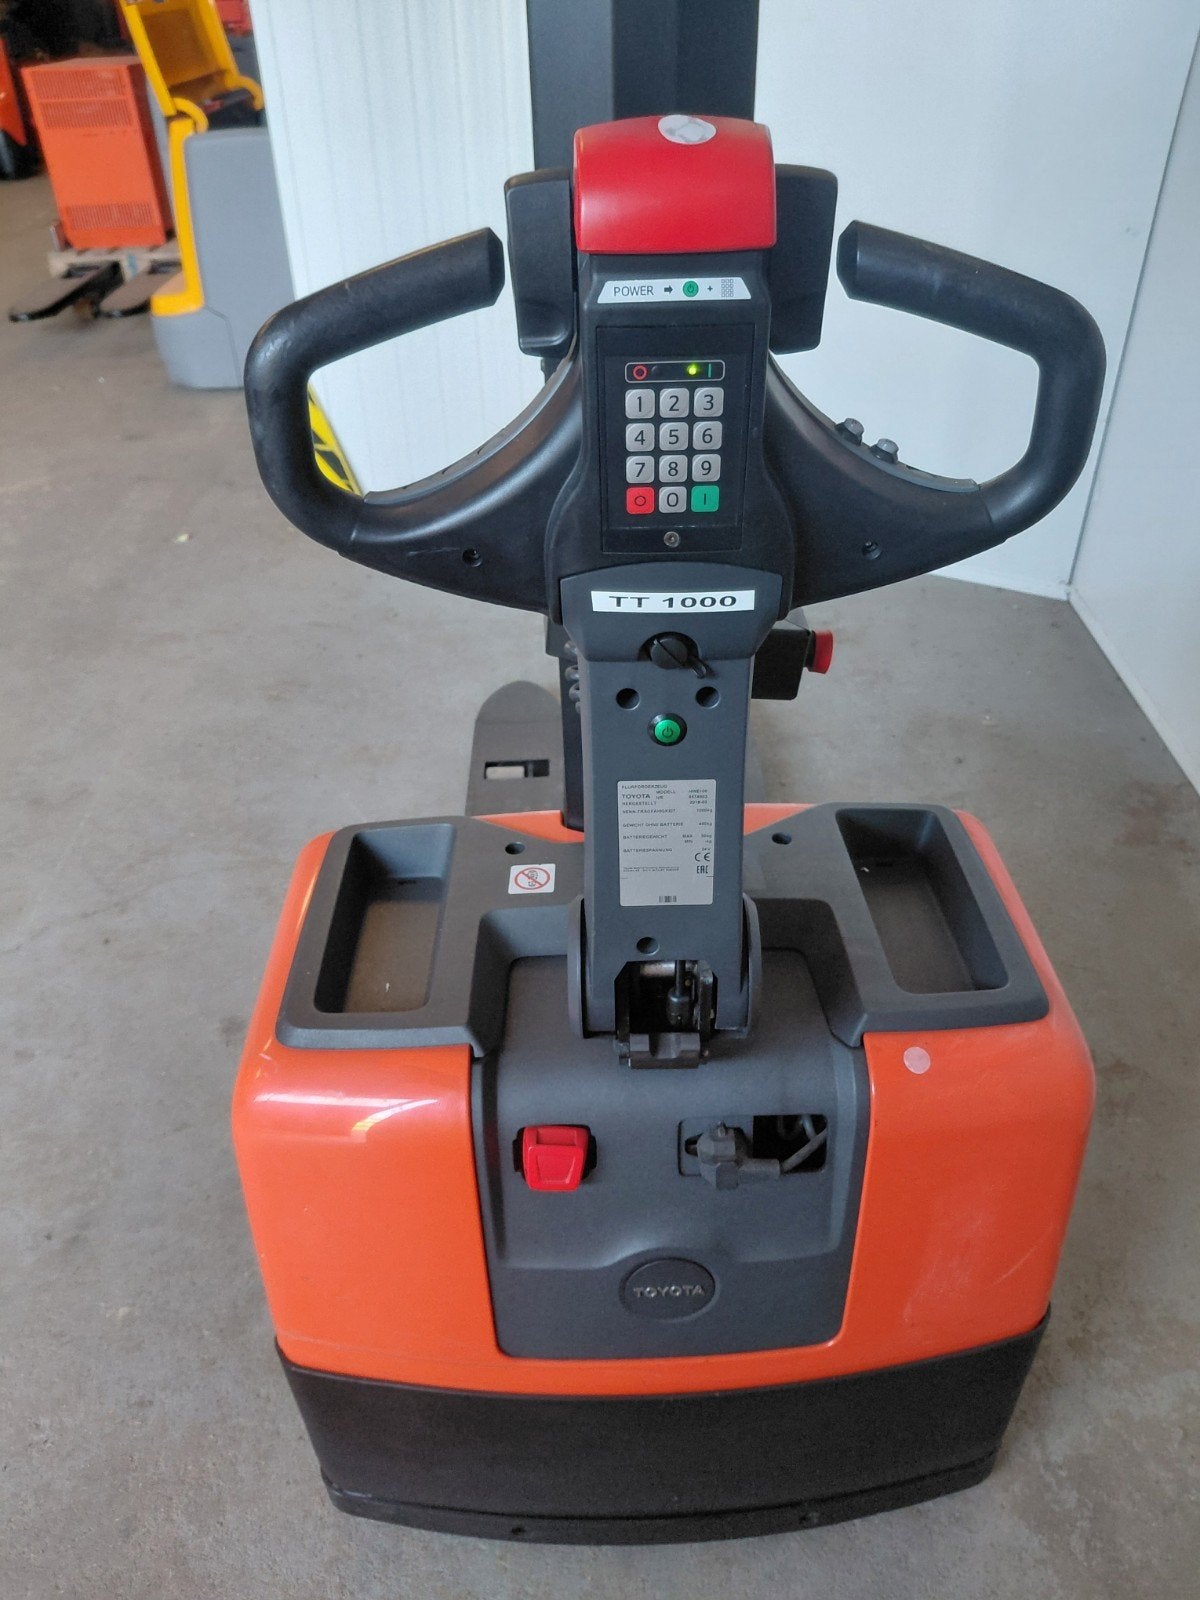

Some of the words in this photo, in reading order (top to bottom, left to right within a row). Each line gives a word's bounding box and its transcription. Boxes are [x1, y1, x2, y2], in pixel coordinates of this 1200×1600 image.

[614, 285, 654, 296] POWER
[637, 396, 643, 412] 1
[668, 395, 680, 411] 2
[703, 394, 714, 411] 3
[634, 430, 646, 445] 4
[668, 429, 679, 444] 5
[702, 428, 713, 443] 6
[635, 463, 646, 477] 7
[668, 461, 678, 476] 8
[701, 460, 711, 475] 9
[609, 595, 650, 608] TT
[662, 595, 737, 608] 1000
[633, 1284, 705, 1298] TOYOTA
